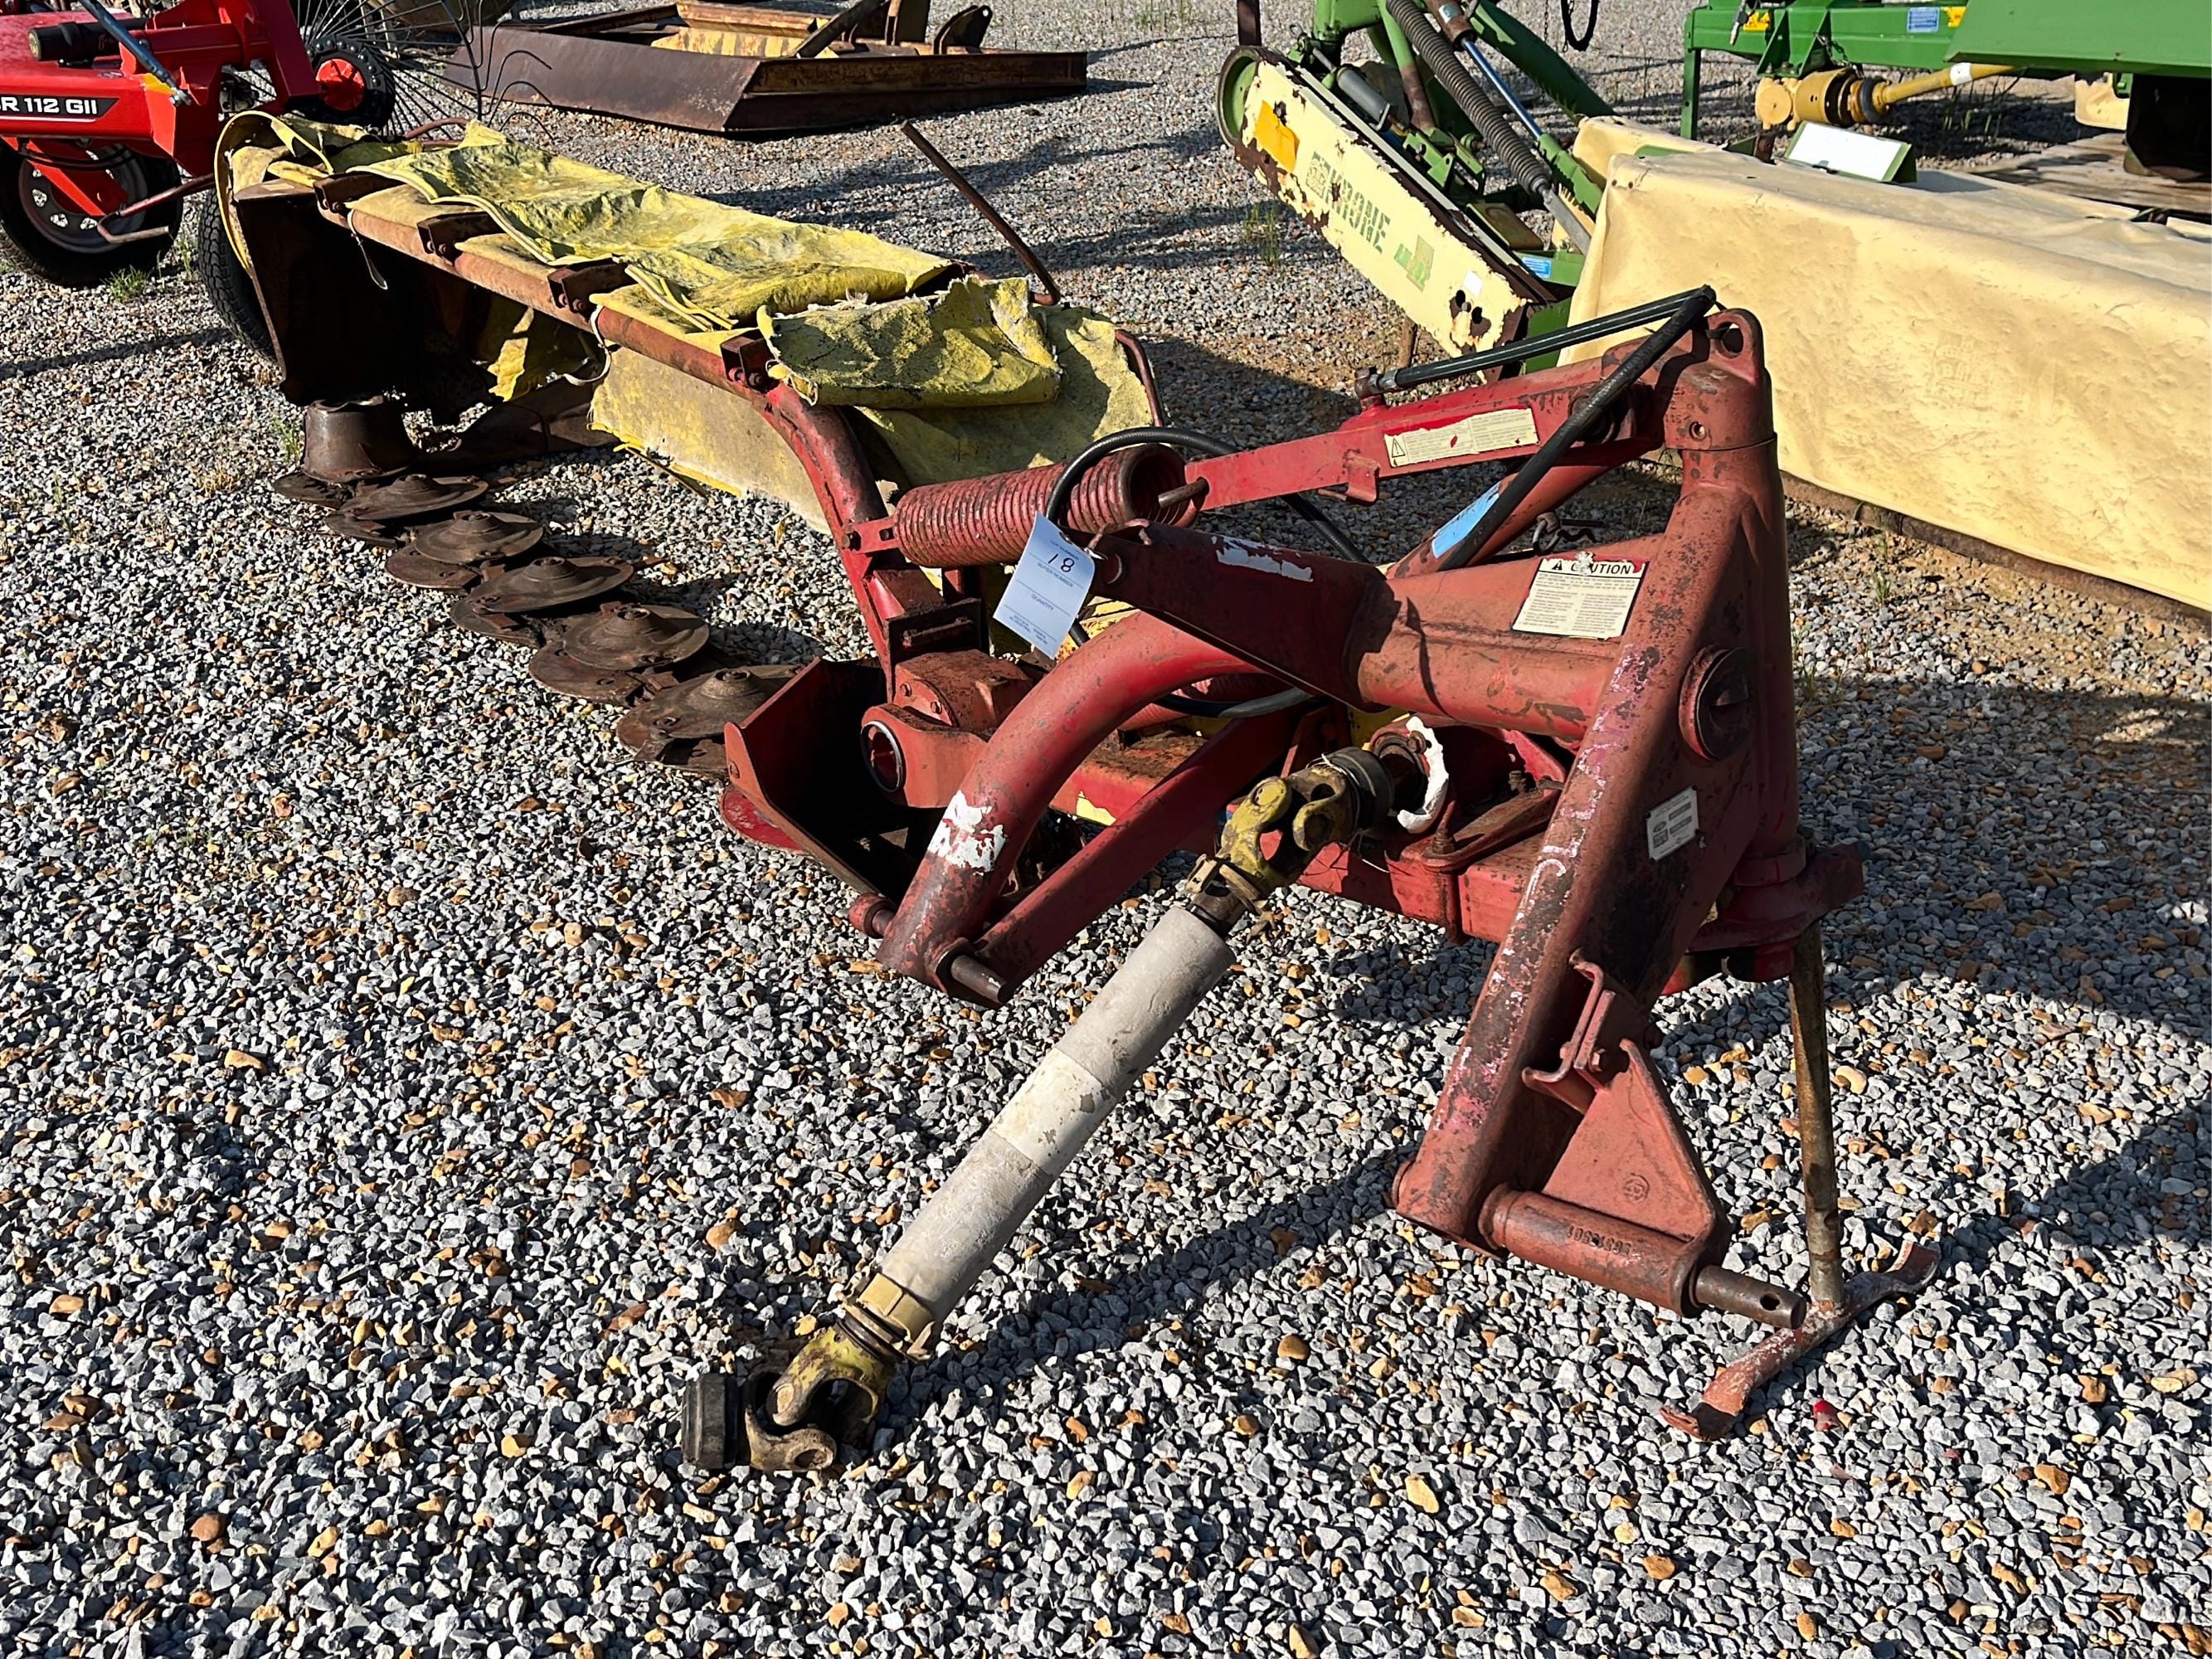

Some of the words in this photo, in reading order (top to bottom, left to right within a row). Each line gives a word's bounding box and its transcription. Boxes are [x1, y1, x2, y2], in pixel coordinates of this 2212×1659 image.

[0, 96, 20, 112] R
[24, 97, 60, 113] 112
[66, 99, 97, 114] GII
[1325, 168, 1391, 254] KRONE
[1048, 553, 1075, 572] 18
[1571, 562, 1631, 574] CUTION
[1053, 571, 1074, 588] NUMBER
[1031, 593, 1055, 611] QUANTITY
